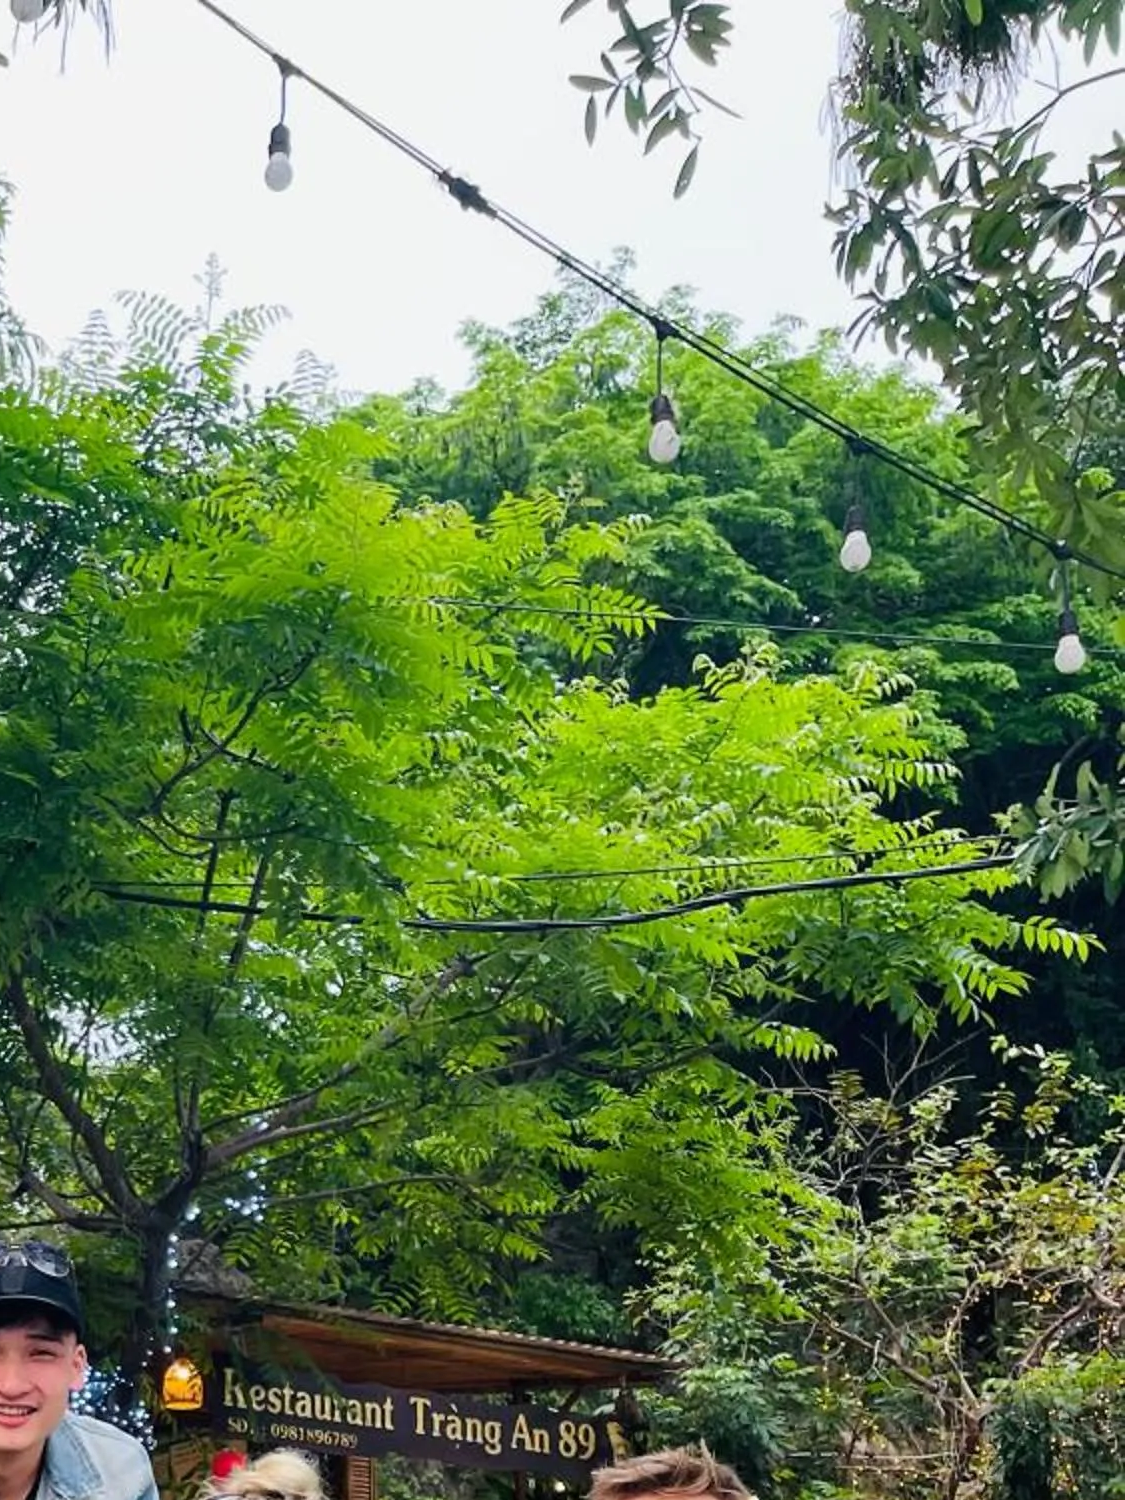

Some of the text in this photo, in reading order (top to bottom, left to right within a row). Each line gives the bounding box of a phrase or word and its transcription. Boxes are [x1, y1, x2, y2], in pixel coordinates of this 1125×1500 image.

[223, 1367, 596, 1460] Restaurant Tràng An 89
